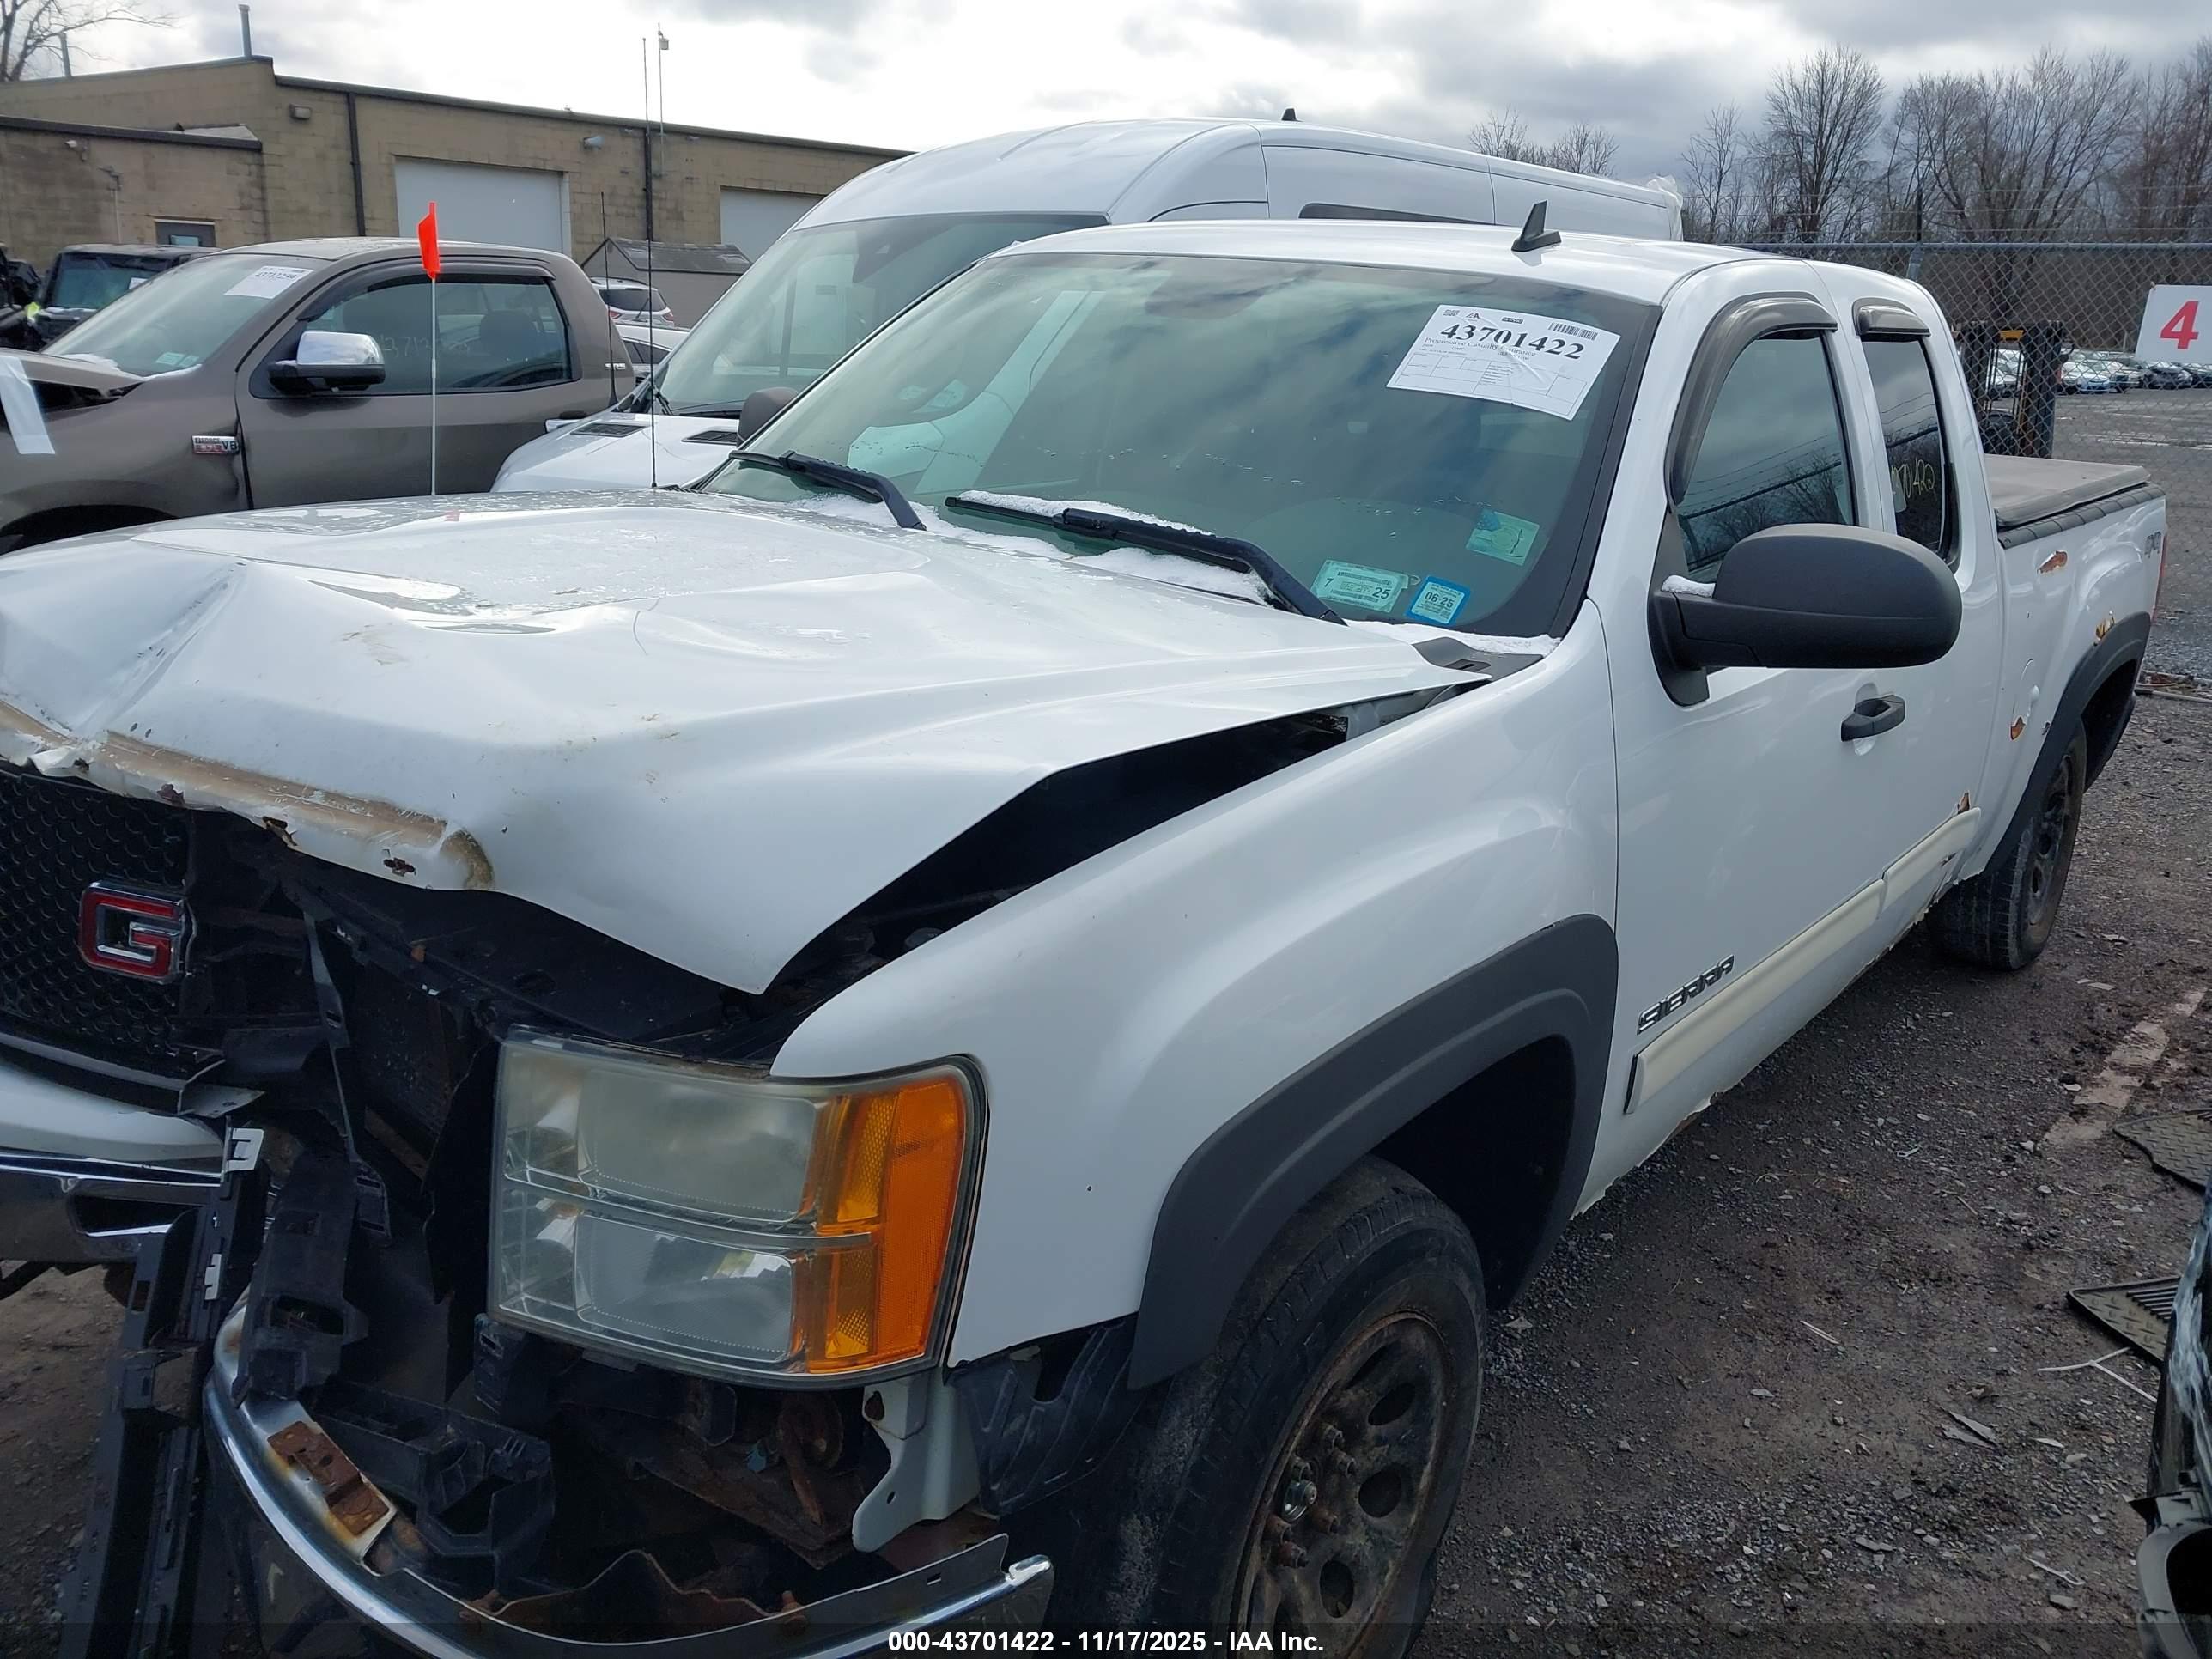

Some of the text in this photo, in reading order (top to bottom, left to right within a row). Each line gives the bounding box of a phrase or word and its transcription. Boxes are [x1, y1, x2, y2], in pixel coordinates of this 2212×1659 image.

[1425, 337, 1465, 347] Progressive
[1468, 340, 1499, 350] Casualty
[1440, 323, 1584, 360] 43701422
[2160, 301, 2199, 349] 4
[1324, 577, 1334, 587] 7
[1372, 586, 1391, 599] 25
[78, 879, 185, 985] G
[1636, 953, 1735, 1036] SIERRA
